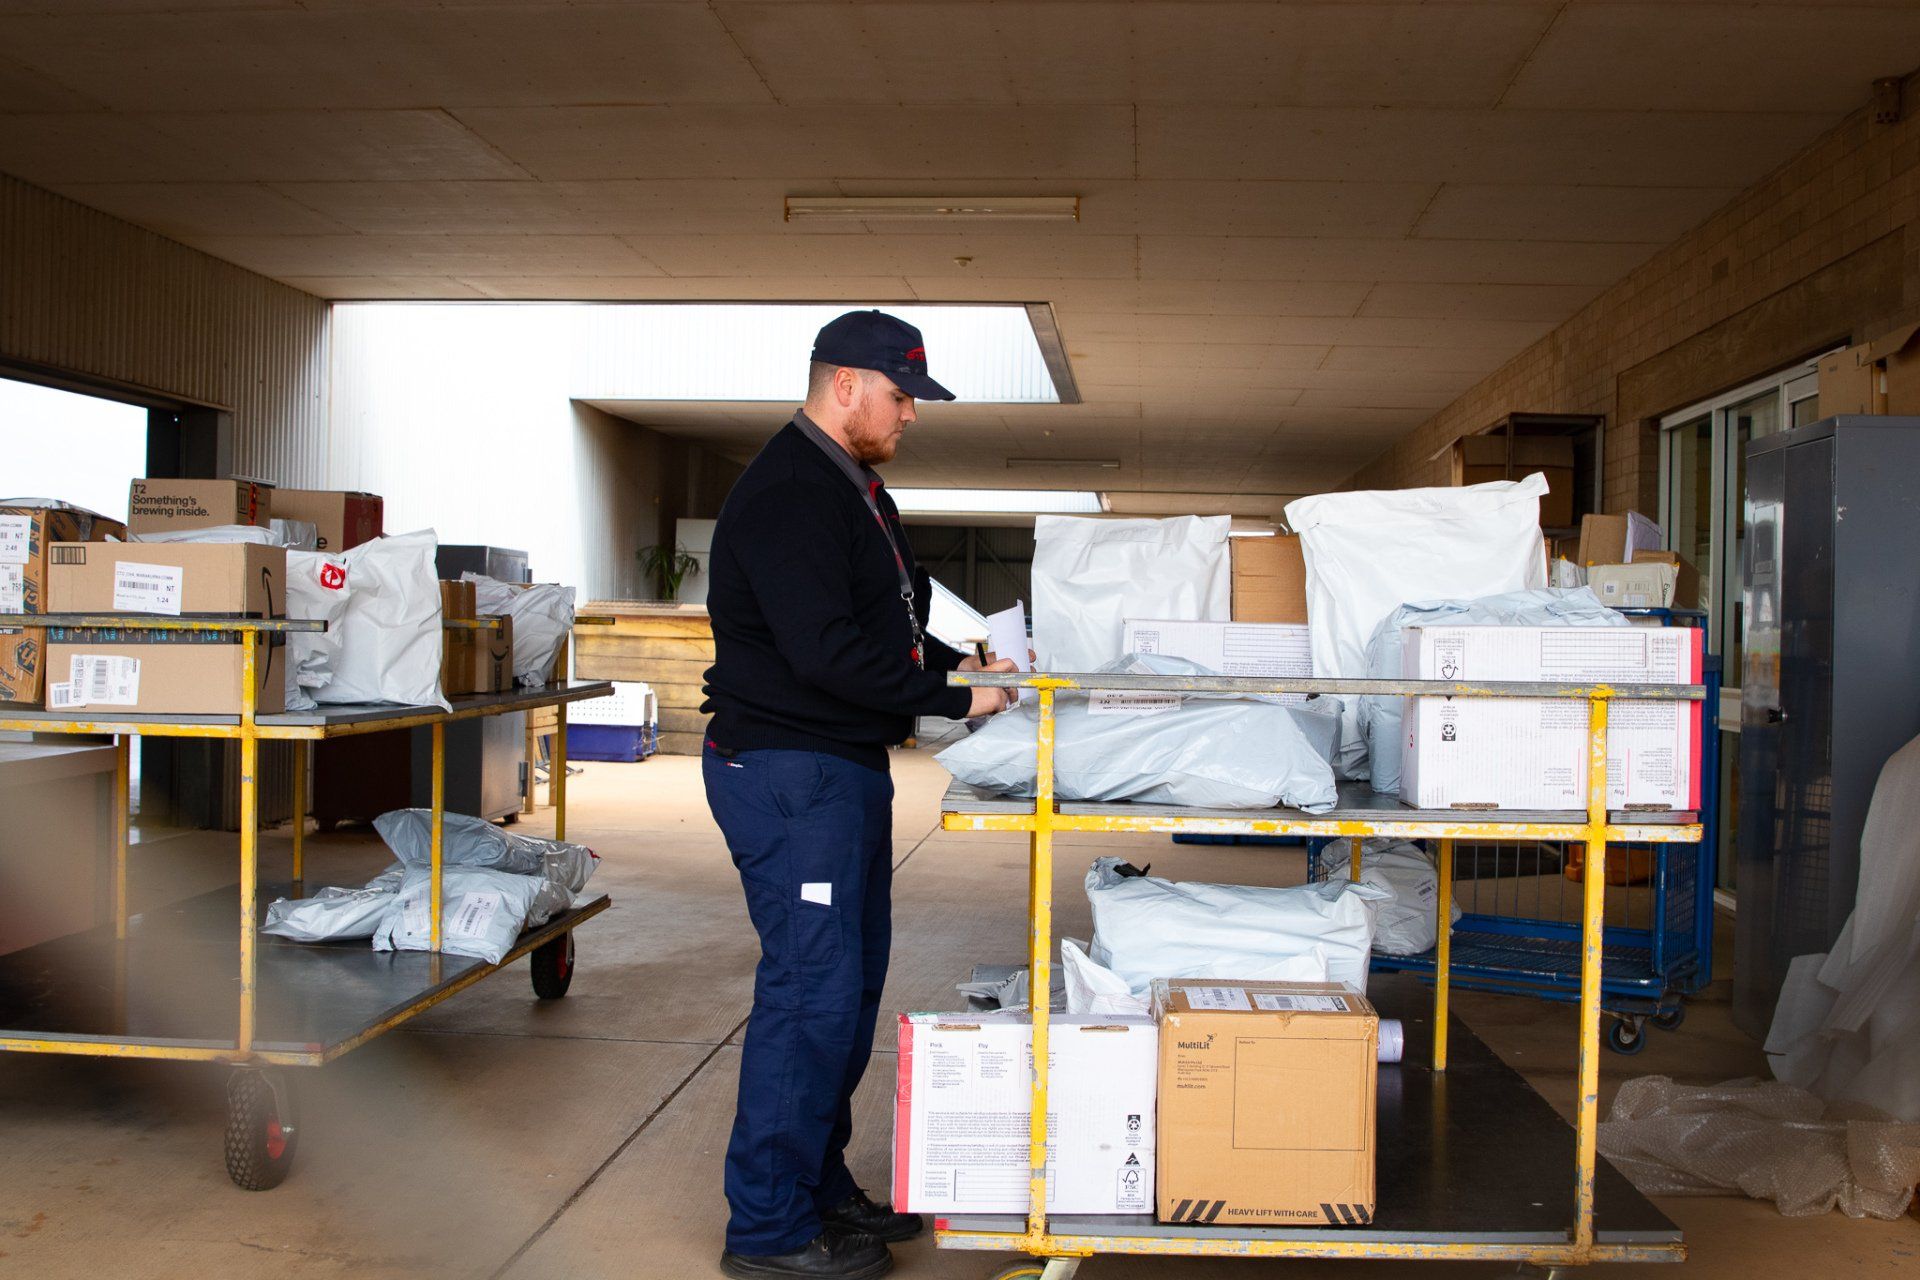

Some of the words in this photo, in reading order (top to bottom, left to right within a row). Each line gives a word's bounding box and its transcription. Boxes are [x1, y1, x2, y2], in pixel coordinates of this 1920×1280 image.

[133, 484, 147, 494] T2
[132, 495, 197, 508] Something's
[132, 505, 174, 518] brewing
[176, 506, 210, 517] inside.
[1177, 1041, 1210, 1050] MultiLit
[1227, 1208, 1254, 1216] HEAVY
[1255, 1209, 1272, 1217] LIFT
[1295, 1210, 1318, 1218] CARE
